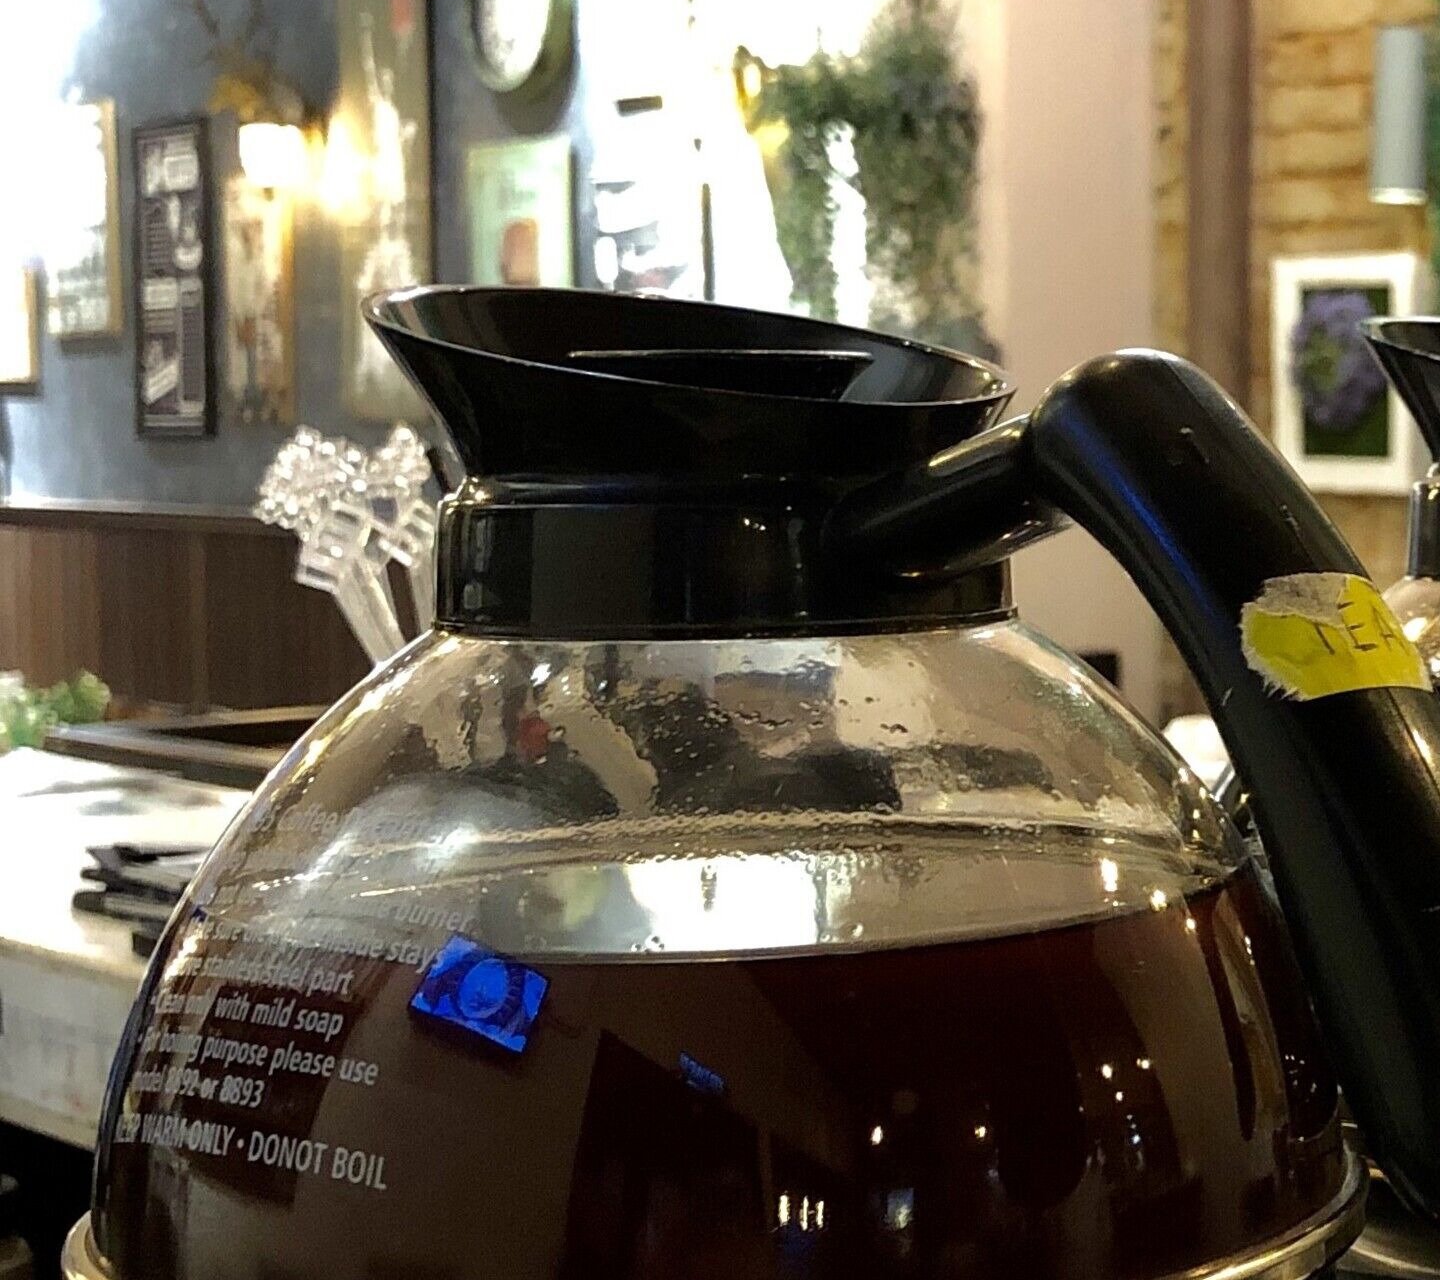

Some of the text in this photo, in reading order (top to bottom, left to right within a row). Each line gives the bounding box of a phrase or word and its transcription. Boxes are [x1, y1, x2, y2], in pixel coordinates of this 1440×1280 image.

[308, 968, 355, 998] part
[214, 992, 250, 1020] with
[251, 997, 297, 1029] mild
[293, 1010, 344, 1043] soap
[201, 1036, 269, 1068] purpose
[269, 1041, 336, 1077] please
[339, 1058, 379, 1087] use
[187, 1119, 236, 1157] ONLY
[331, 1146, 387, 1191] BOIL
